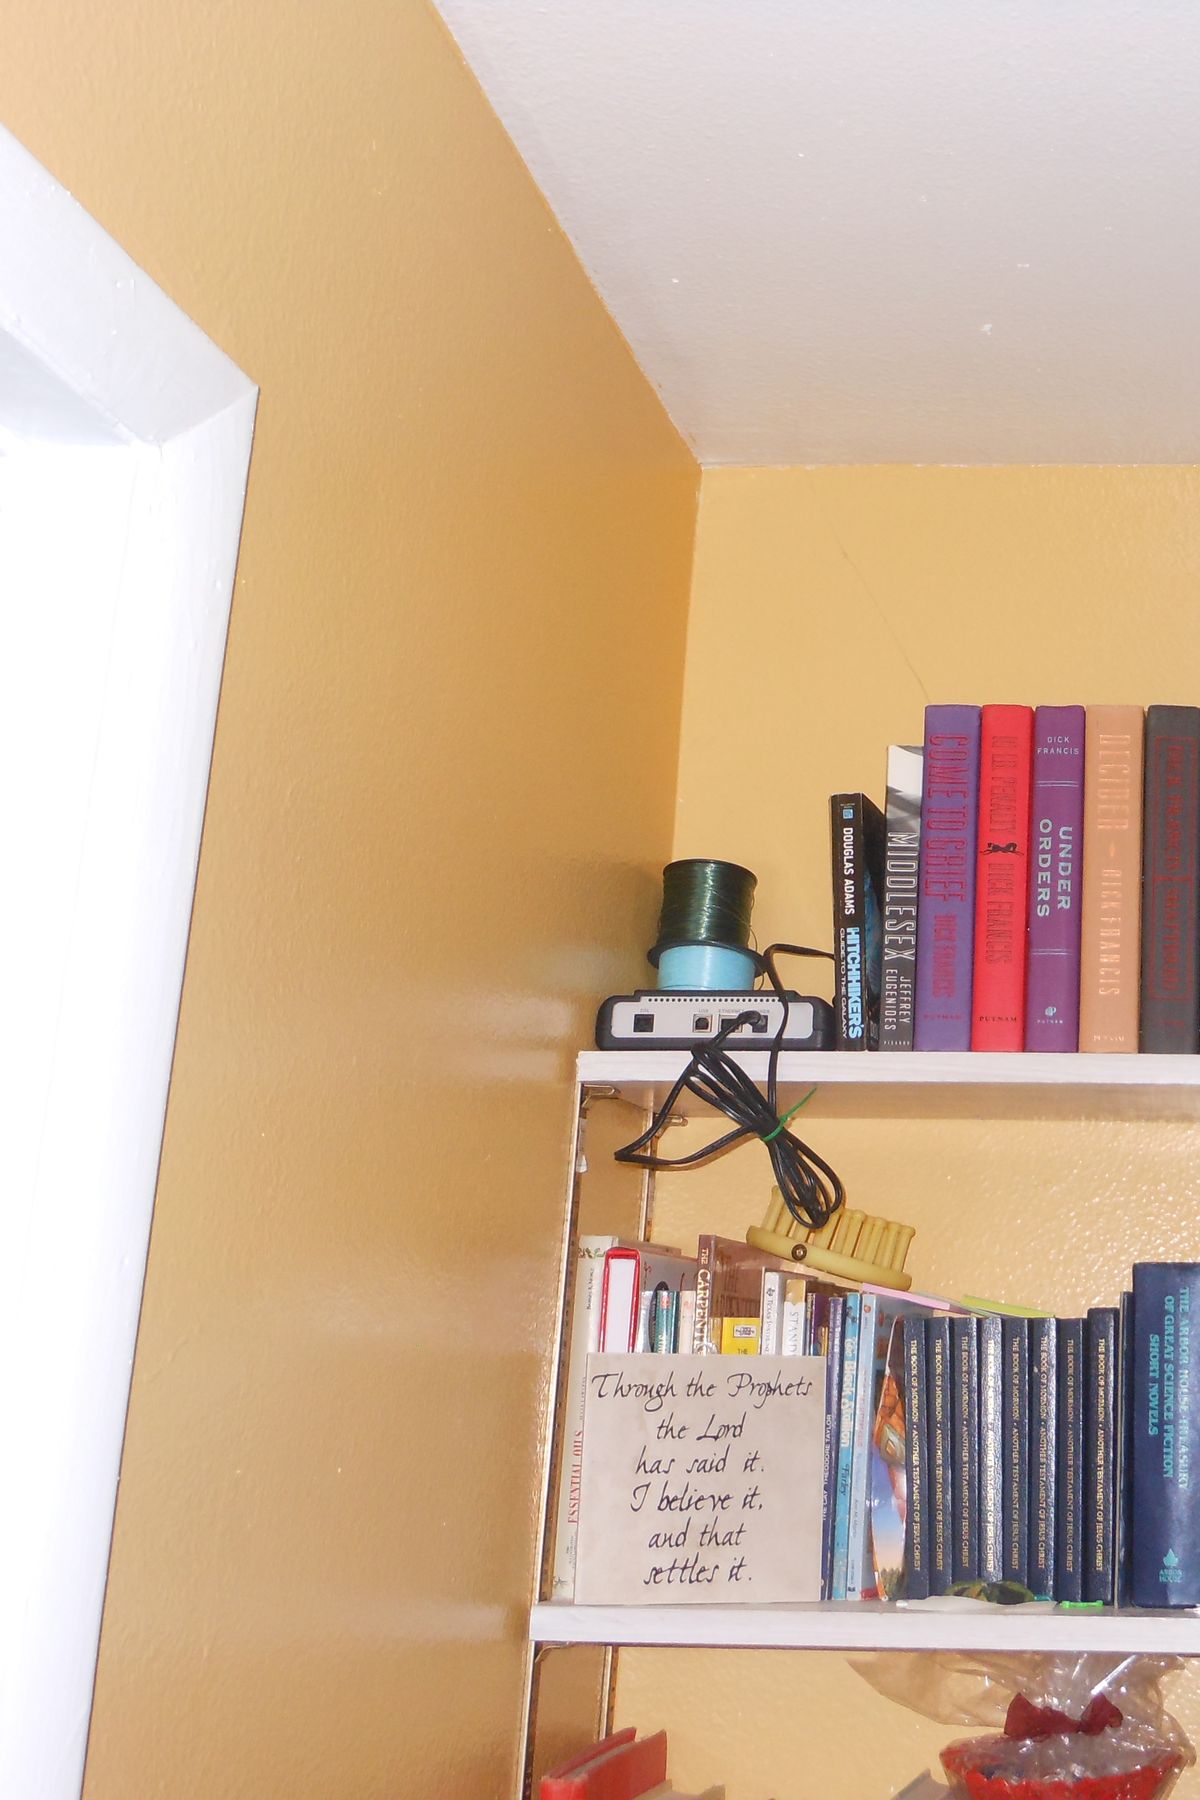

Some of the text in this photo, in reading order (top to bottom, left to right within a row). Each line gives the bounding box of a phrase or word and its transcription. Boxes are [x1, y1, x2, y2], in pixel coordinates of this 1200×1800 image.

[927, 734, 970, 799] COME
[1098, 734, 1131, 830] DECIDER
[927, 806, 968, 832] TO
[843, 827, 855, 915] DOUGLAS ADAMS
[923, 838, 966, 903] GRIEF
[1036, 819, 1054, 917] ORDERS
[1056, 826, 1074, 910] UNDER
[884, 832, 919, 961] MIDDLESEX
[985, 901, 1014, 965] FRANCIS
[1099, 869, 1122, 996] DICK FRANCIS
[840, 960, 847, 974] TO
[846, 927, 864, 1039] HITCHHIKER'S
[884, 969, 898, 1030] EUGENIDES
[899, 976, 912, 1023] JEFFREY
[978, 1015, 1018, 1023] PUTNAM
[1179, 1286, 1190, 1313] THE
[1178, 1318, 1190, 1365] ARBOR
[591, 1371, 677, 1412] Through
[686, 1371, 716, 1398] the
[727, 1370, 813, 1409] Prophets
[843, 1361, 856, 1396] Black
[1098, 1376, 1105, 1385] OF
[1148, 1334, 1160, 1436] SHORT NOVELS
[1163, 1296, 1175, 1478] OF GREAT SCIENCE FICTION
[1178, 1369, 1190, 1413] HOUSE
[657, 1411, 747, 1441] the Lord
[841, 1398, 855, 1448] Stallion
[636, 1444, 765, 1474] has said it.
[823, 1444, 831, 1485] THEODORE
[839, 1464, 851, 1496] Farley
[630, 1482, 652, 1512] I
[657, 1480, 734, 1512] believe
[1097, 1511, 1104, 1521] OF
[648, 1516, 747, 1548] and that
[644, 1552, 753, 1585] settles it.
